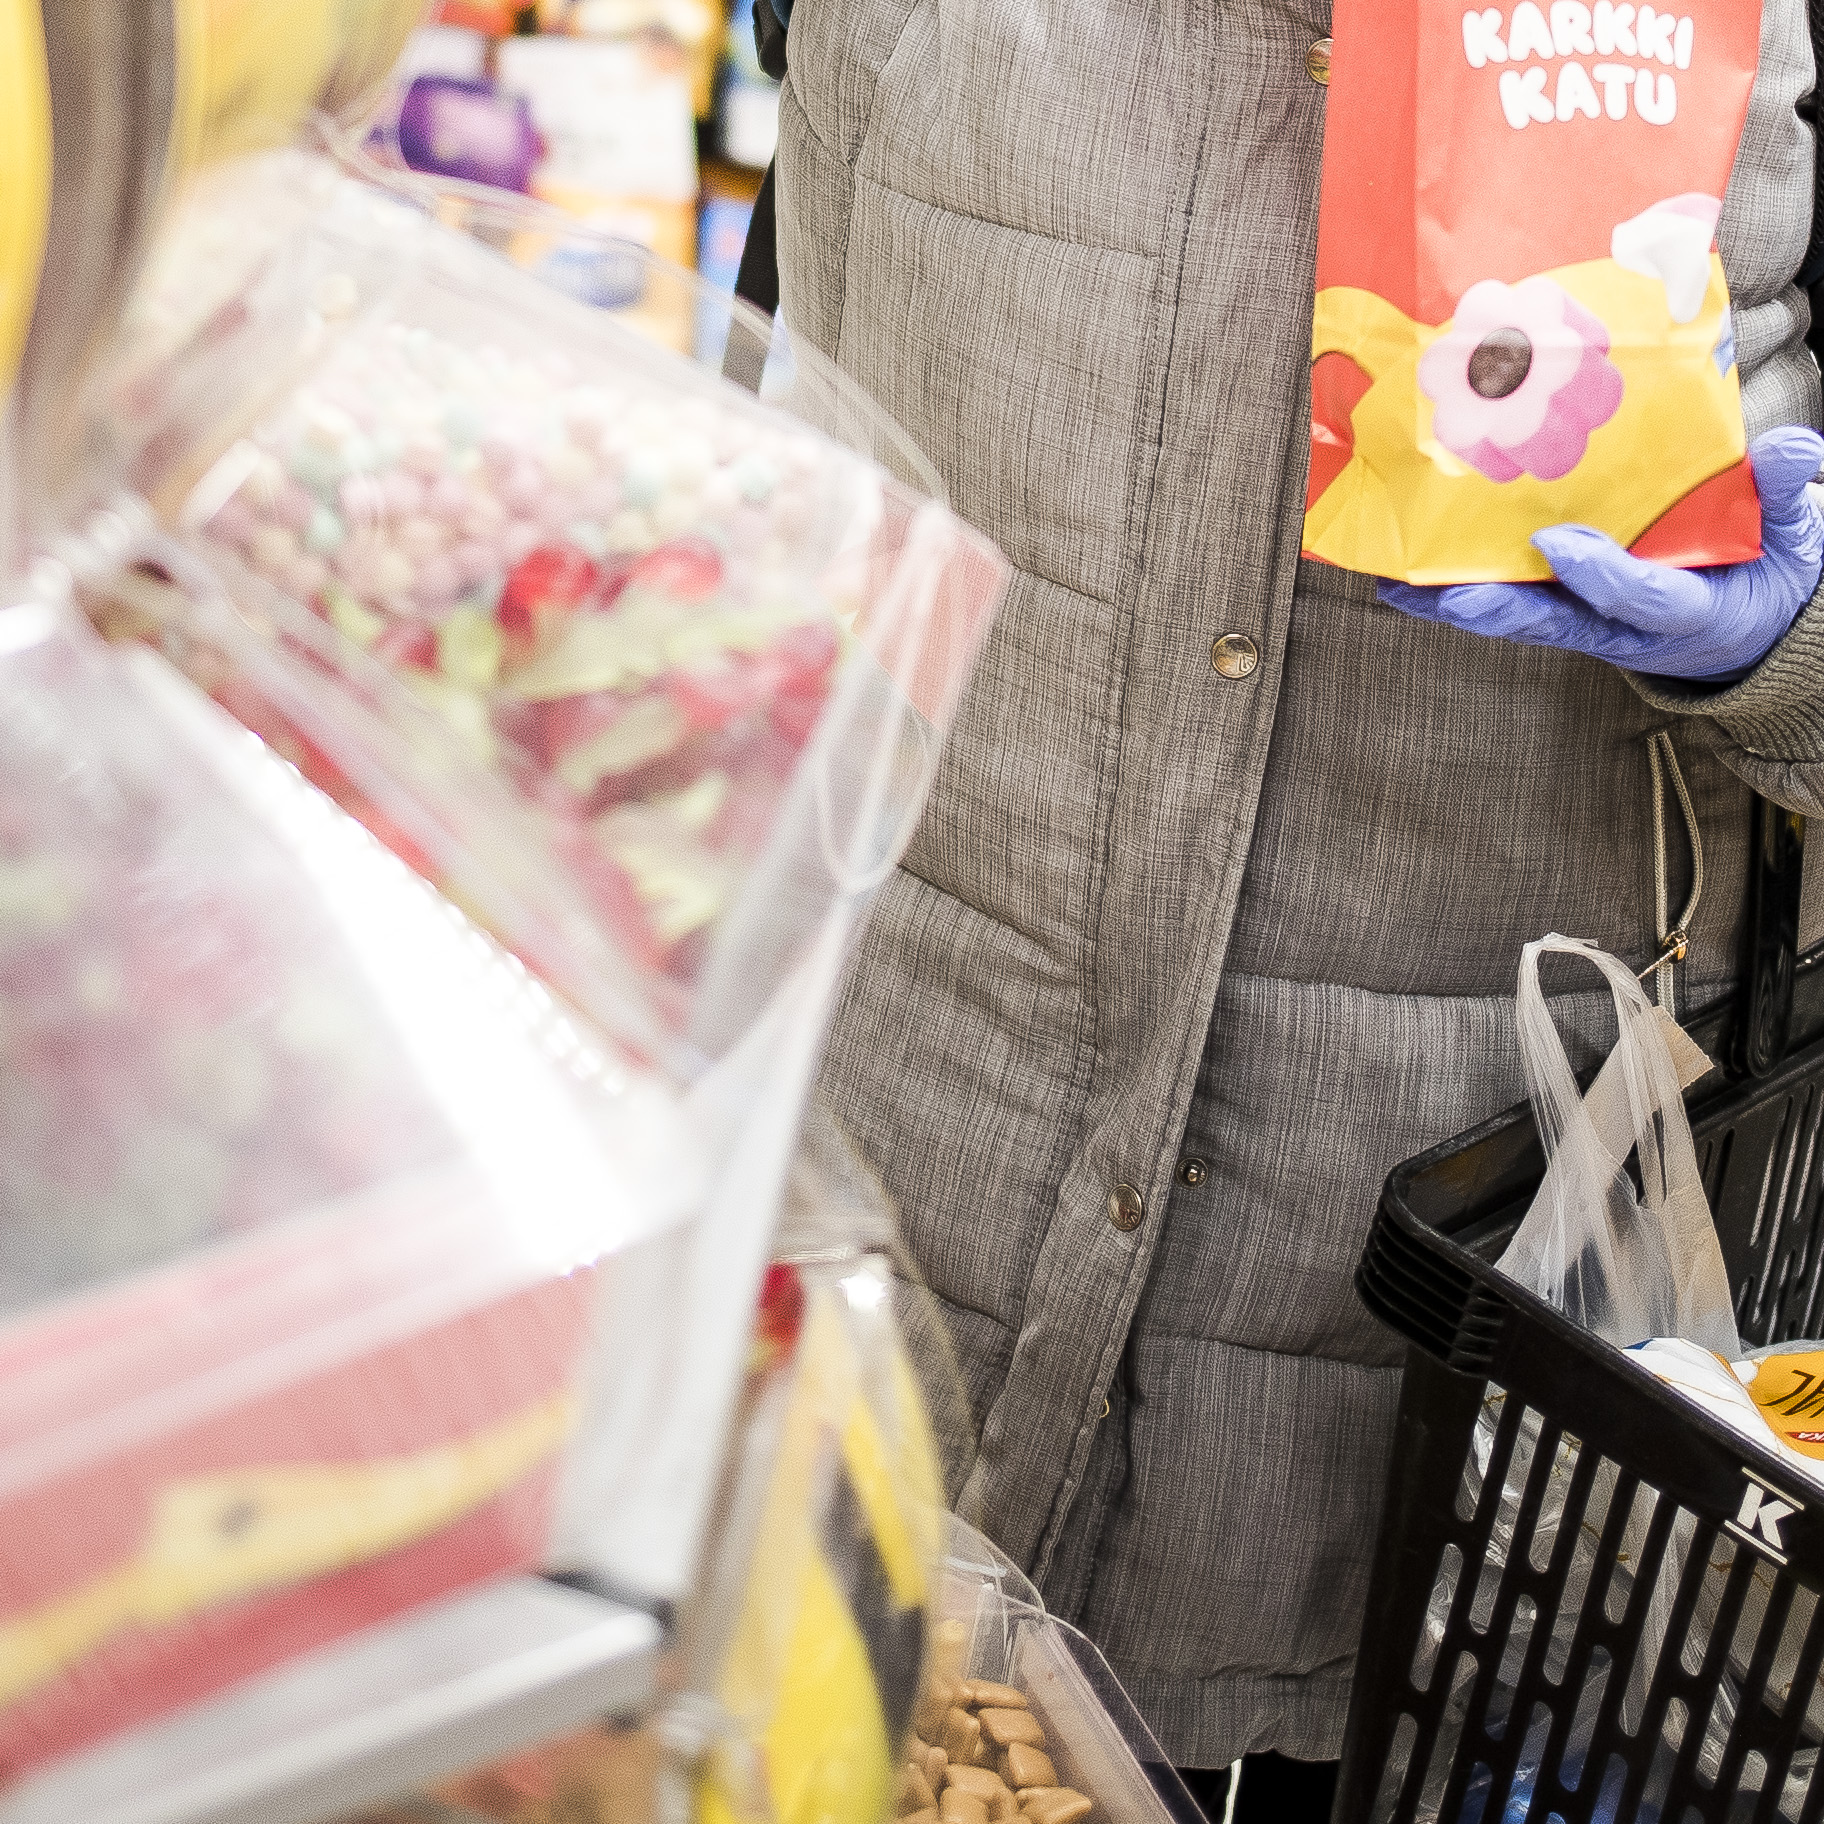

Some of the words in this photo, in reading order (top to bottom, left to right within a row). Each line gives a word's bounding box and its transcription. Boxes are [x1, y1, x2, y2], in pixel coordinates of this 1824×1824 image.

[1462, 0, 1694, 71] KARKKI
[1498, 62, 1678, 130] KATU
[1736, 1481, 1796, 1551] K
